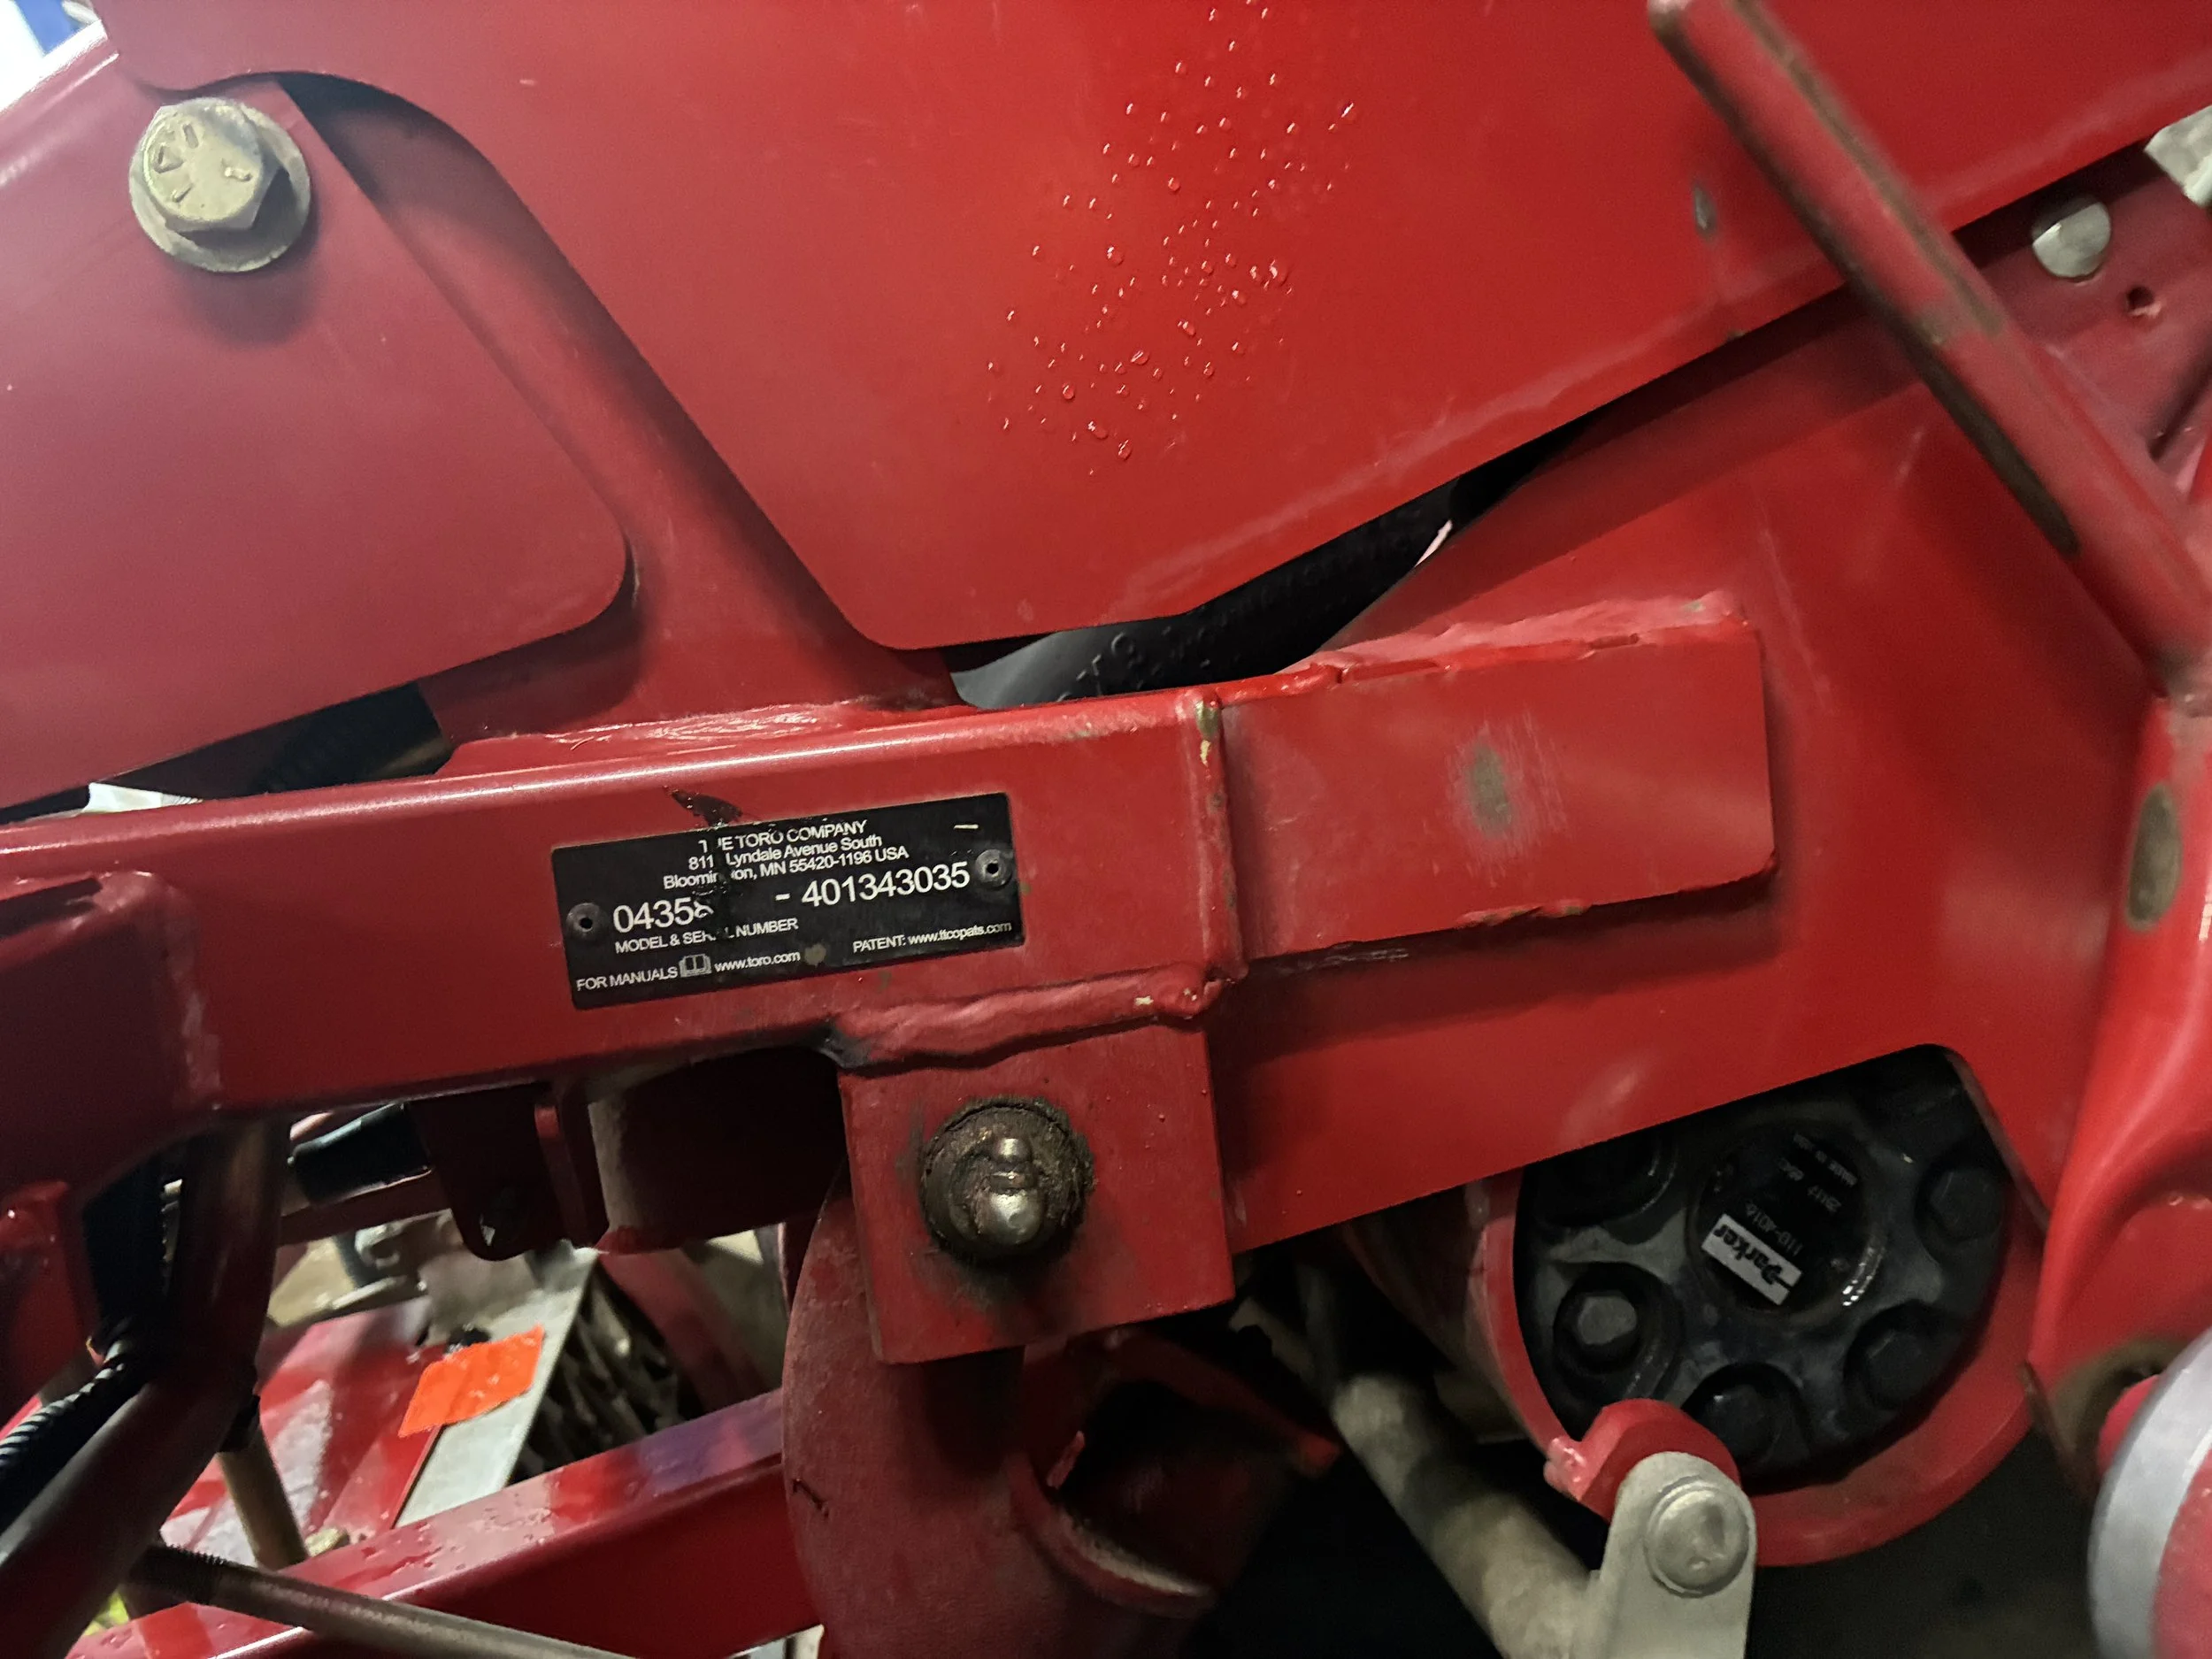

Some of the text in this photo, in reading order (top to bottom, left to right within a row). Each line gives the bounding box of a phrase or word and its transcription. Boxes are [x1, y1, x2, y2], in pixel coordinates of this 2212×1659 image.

[688, 833, 882, 871] 811 Lyndale Avenue South
[697, 819, 867, 853] TE TORO COMPANY
[760, 861, 787, 877] MN
[789, 850, 872, 873] 55420-1196
[875, 846, 910, 863] USA
[801, 861, 971, 908] 401343035
[616, 936, 669, 954] MODEL
[670, 933, 681, 947] &
[735, 918, 799, 938] NUMBER
[853, 921, 1012, 953] PATENT: www.ttcopats.com
[714, 950, 801, 972] www.toro.com
[576, 965, 679, 992] FOR MANUALS
[1714, 1224, 1783, 1285] Parker
